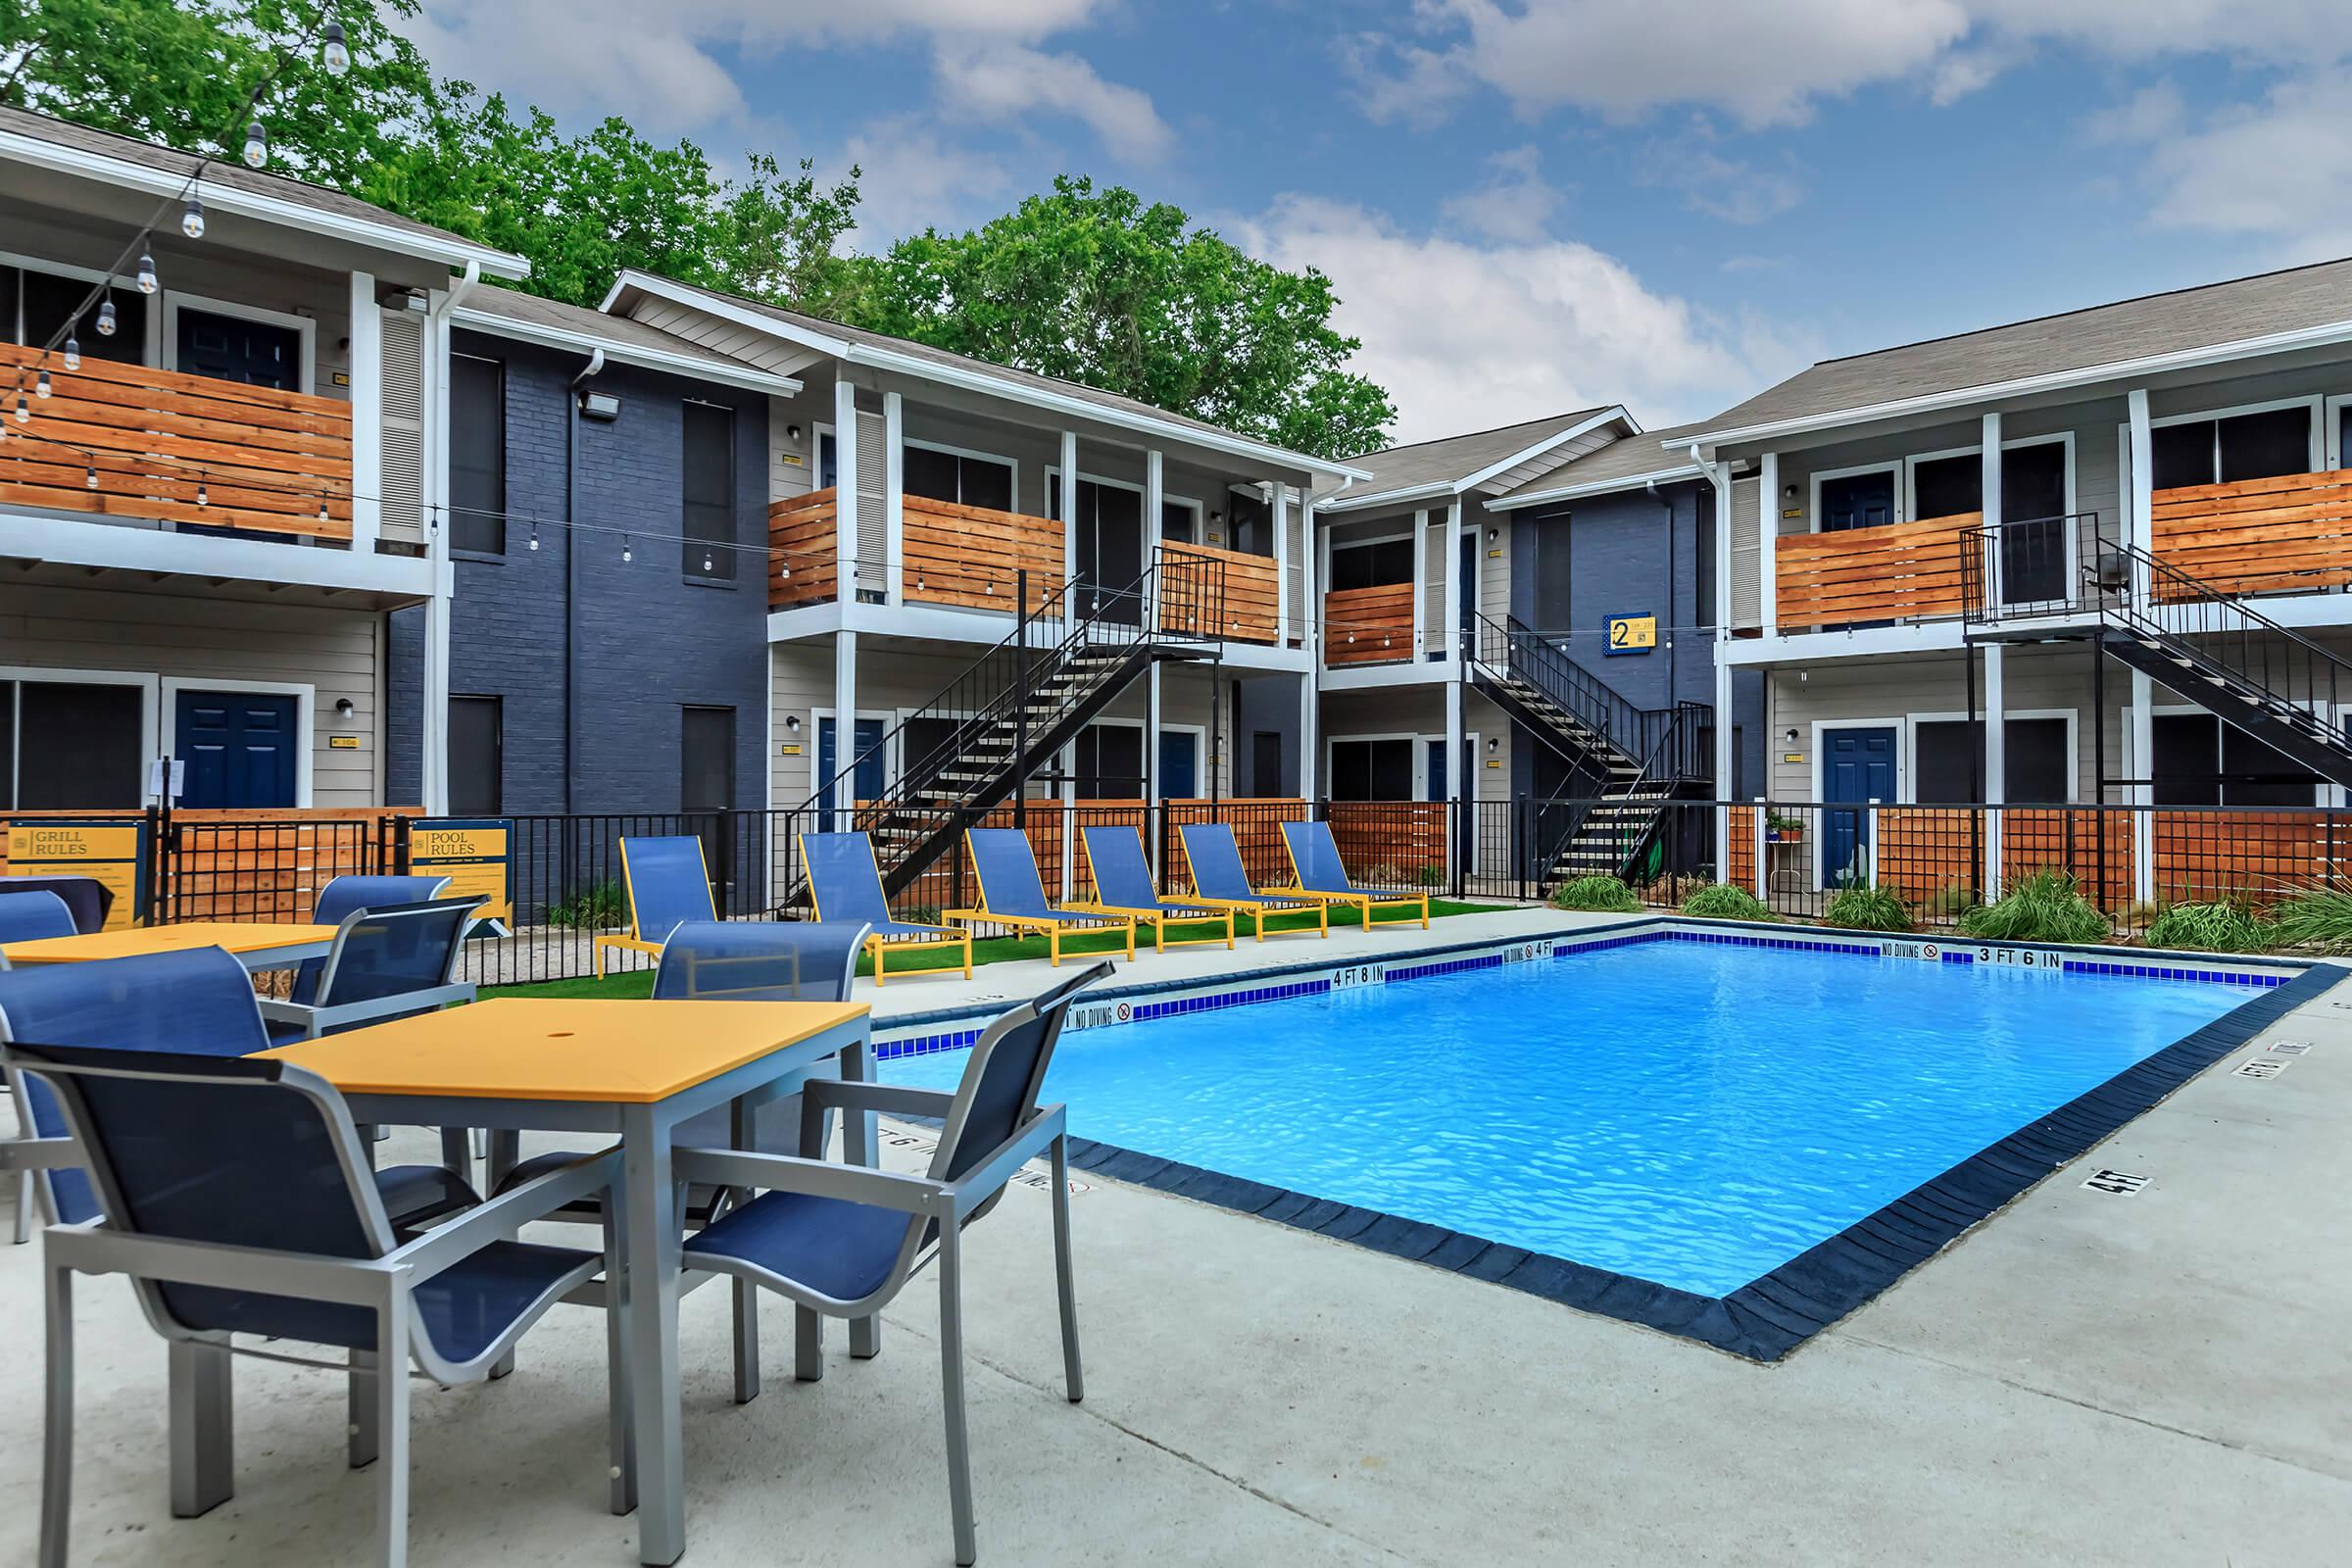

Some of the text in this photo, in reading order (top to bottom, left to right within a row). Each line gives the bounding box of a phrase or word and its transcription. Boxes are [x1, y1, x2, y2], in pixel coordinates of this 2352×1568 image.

[1614, 621, 1629, 646] 2
[35, 831, 82, 842] GRILL
[431, 832, 467, 844] POOL
[35, 844, 87, 855] RULES
[431, 844, 475, 856] RULES
[1536, 942, 1542, 956] 4
[1544, 941, 1552, 956] FT
[1882, 943, 1919, 958] NO DIVING
[1980, 948, 2060, 968] 3 FT 6 IN
[1334, 964, 1384, 987] 4 FT 8 IN
[1075, 1008, 1086, 1028] NO
[1089, 1006, 1112, 1027] DIVING
[2086, 1169, 2149, 1194] 4 FT
